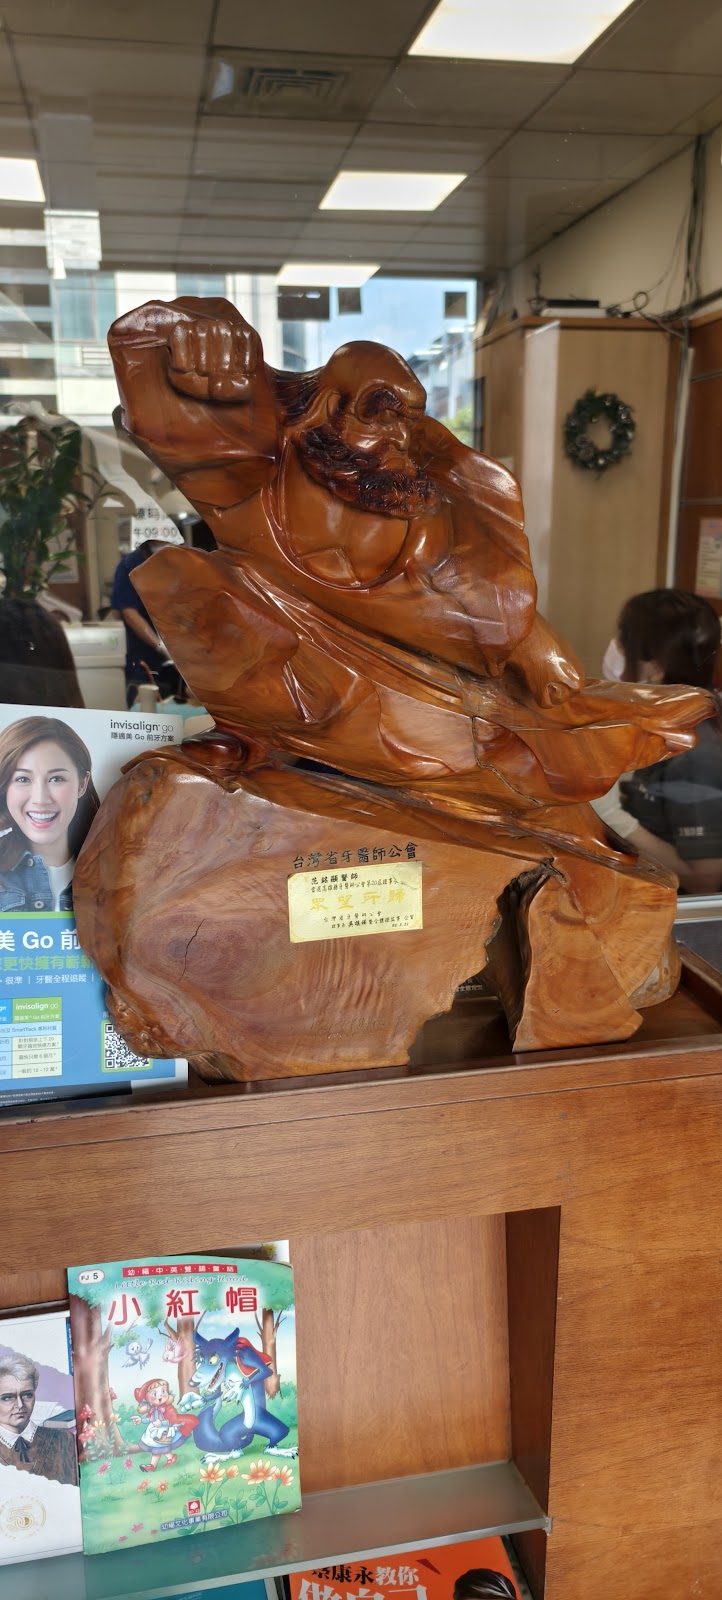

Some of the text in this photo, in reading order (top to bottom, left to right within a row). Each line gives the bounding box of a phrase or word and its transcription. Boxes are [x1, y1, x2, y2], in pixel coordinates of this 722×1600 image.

[110, 720, 174, 733] invisalign go
[147, 734, 175, 742] 前牙方案
[293, 842, 418, 869] 台灣省牙醫師公會
[0, 929, 81, 952] 美 Go 前
[93, 1272, 99, 1280] 5
[115, 1280, 145, 1290] Little
[174, 1276, 214, 1284] Riding
[217, 1274, 249, 1283] Hood
[108, 1287, 257, 1326] 小紅帽
